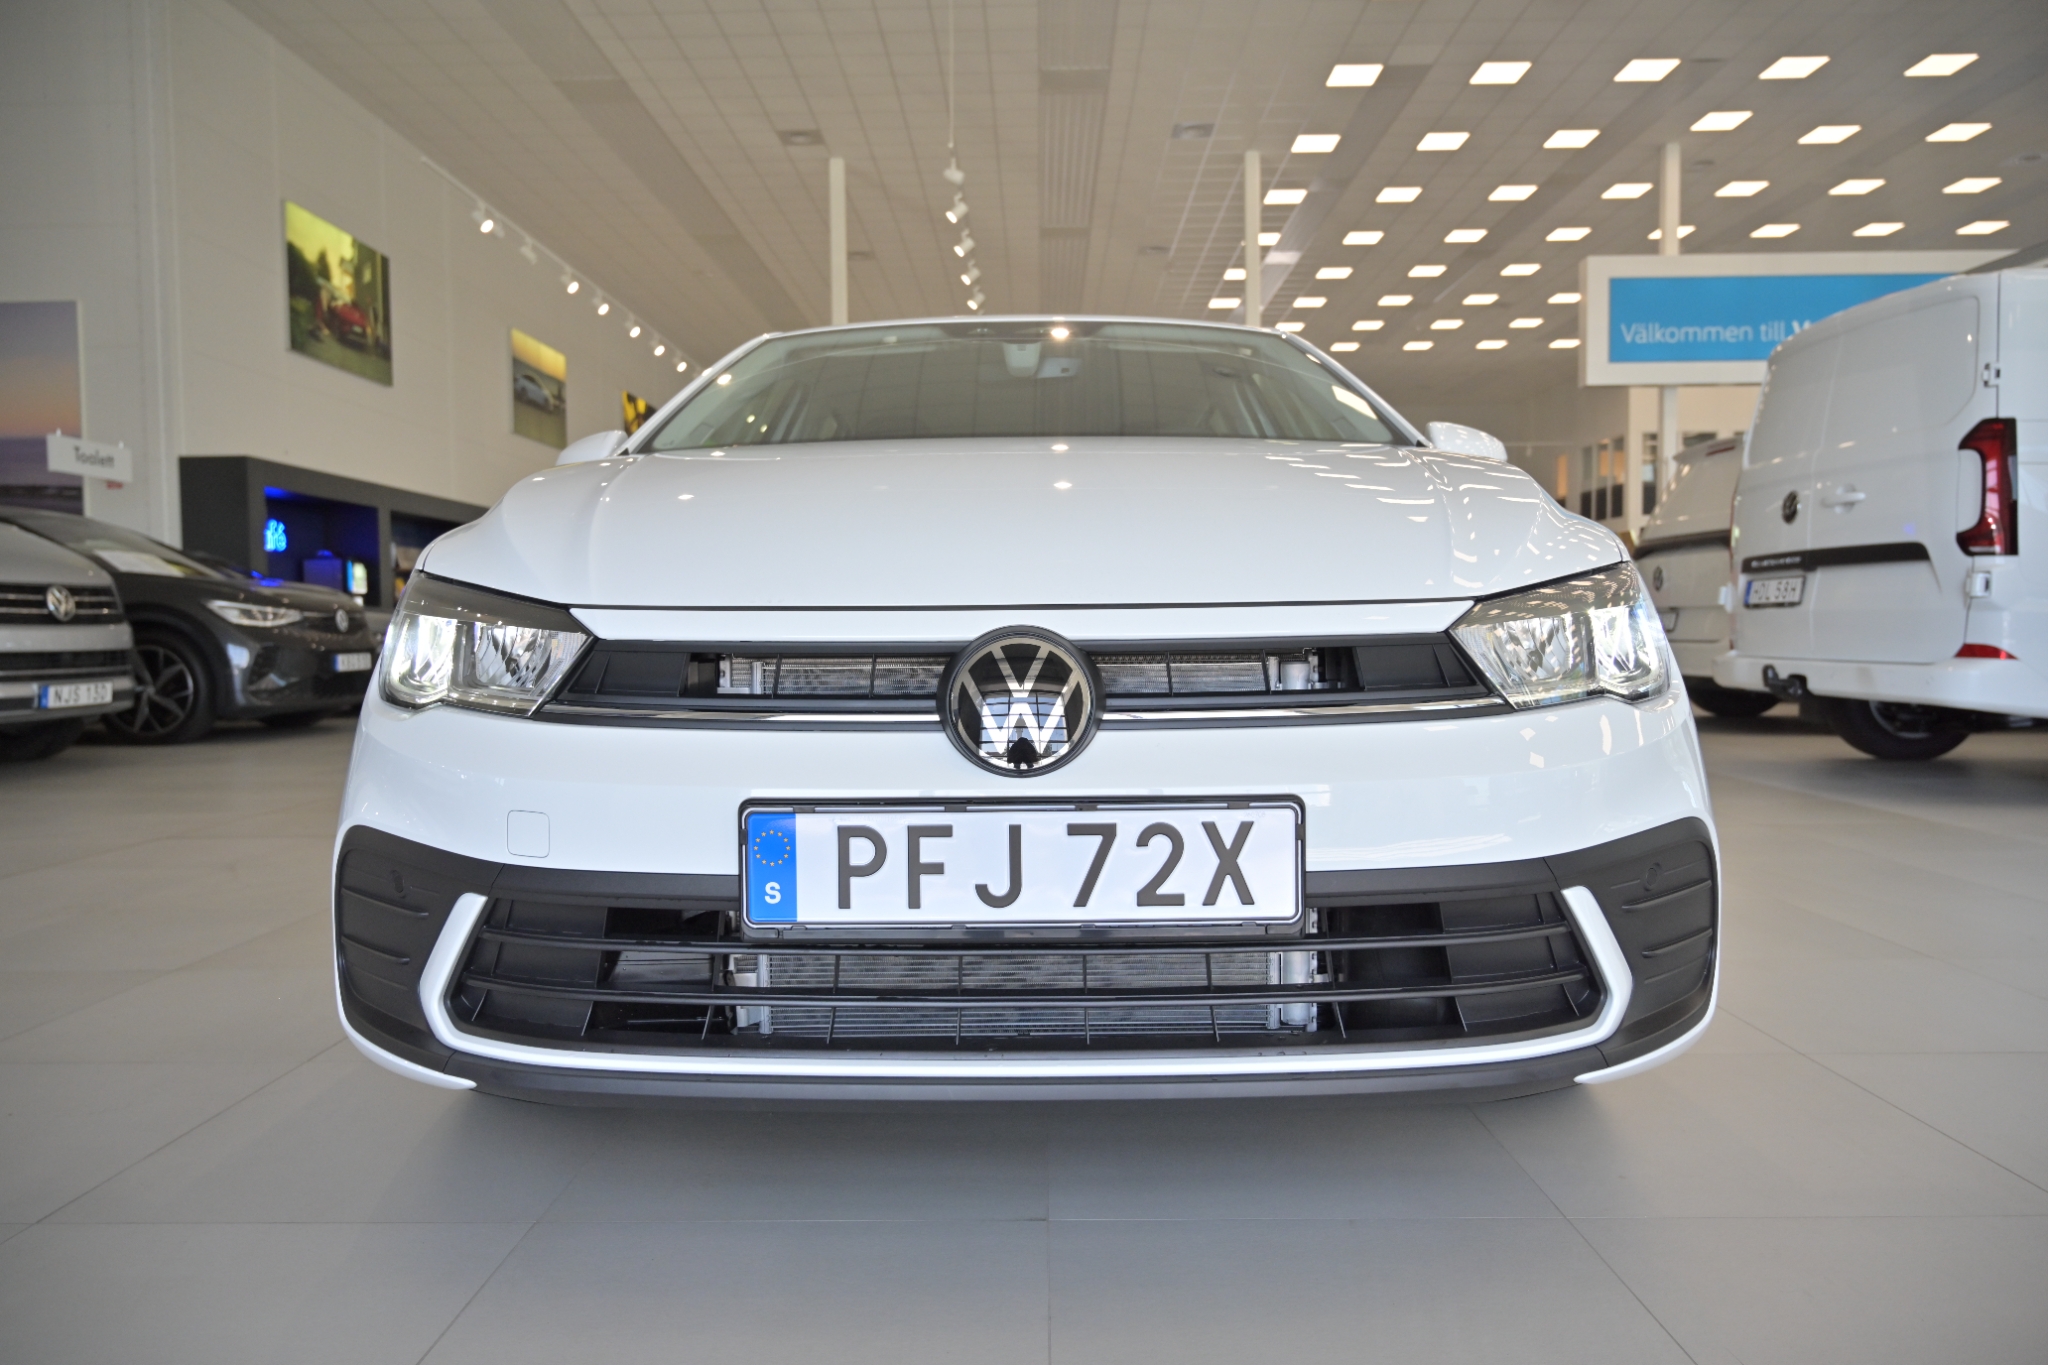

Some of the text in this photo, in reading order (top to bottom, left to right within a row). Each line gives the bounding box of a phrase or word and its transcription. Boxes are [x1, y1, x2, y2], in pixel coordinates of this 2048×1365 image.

[1620, 322, 1753, 344] Välkommen
[1760, 321, 1785, 342] till
[53, 684, 81, 705] NJS
[837, 820, 1256, 910] PFJ 72X
[763, 880, 782, 904] S
